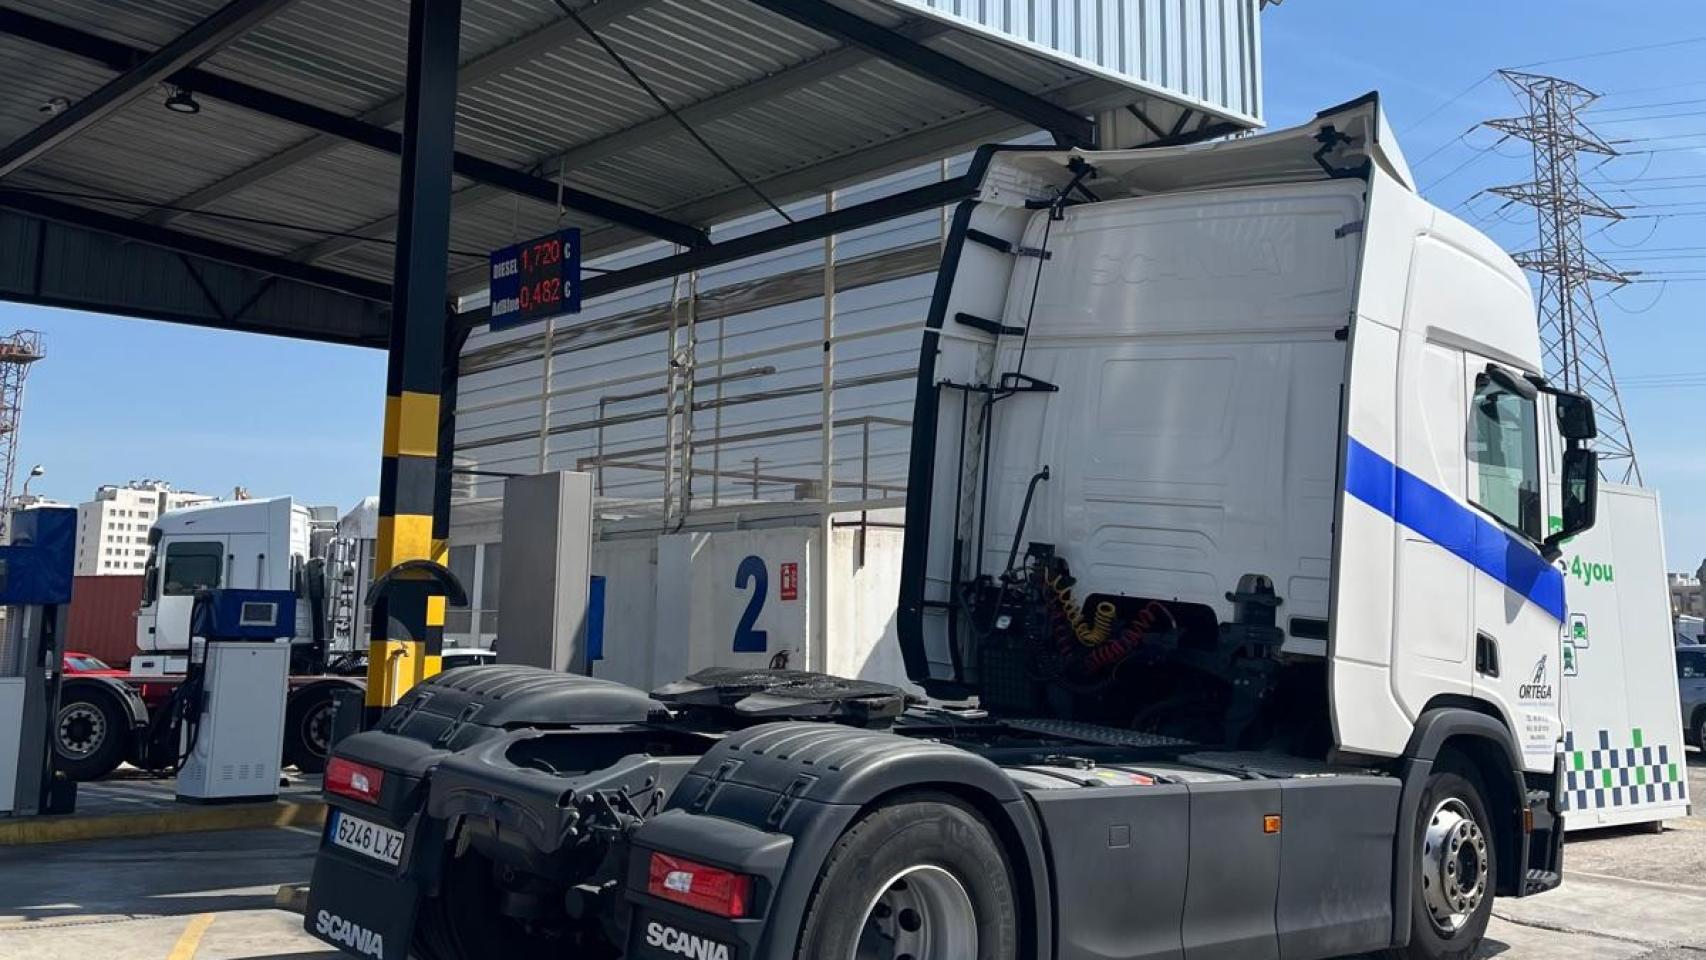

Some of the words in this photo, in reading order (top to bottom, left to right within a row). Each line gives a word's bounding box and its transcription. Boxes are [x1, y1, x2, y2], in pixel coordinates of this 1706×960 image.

[493, 259, 518, 279] DIESEL
[522, 240, 561, 272] 1,720
[520, 278, 561, 311] 0,482
[1571, 554, 1614, 587] 4you
[733, 556, 768, 653] 2
[1519, 684, 1552, 699] ORTEGA
[339, 818, 372, 849] 6246
[374, 830, 403, 860] LXZ
[316, 909, 383, 960] SCANIA
[646, 922, 729, 960] SCANIA
